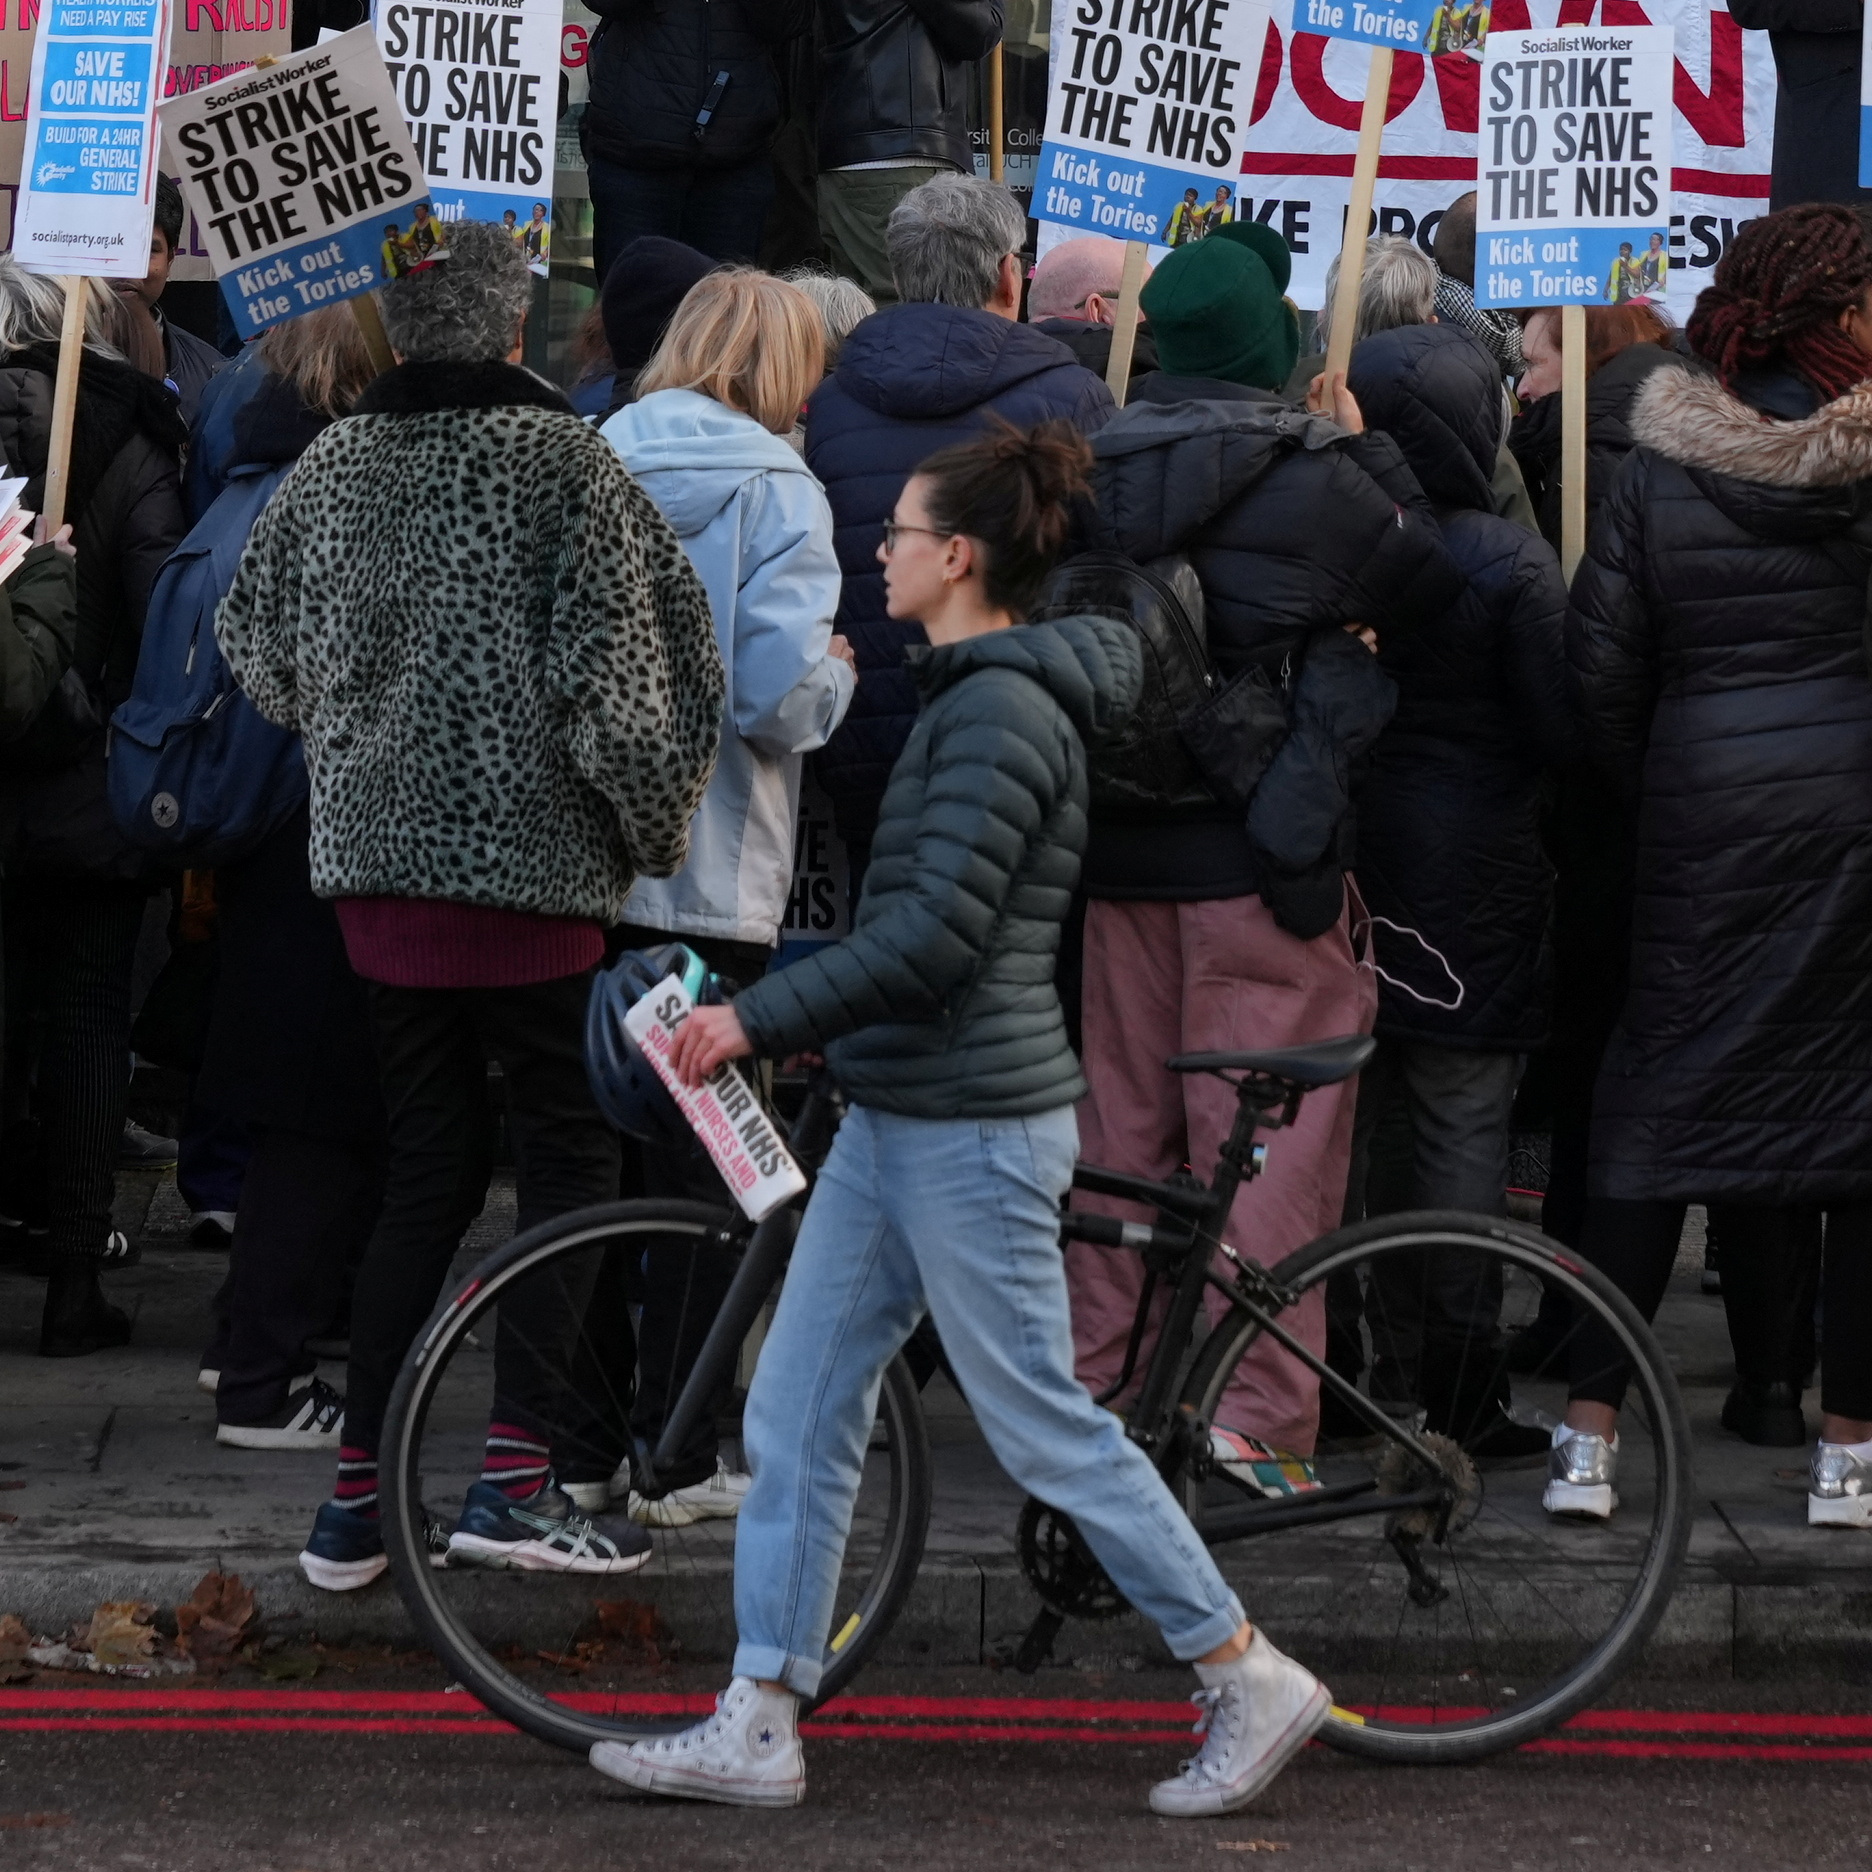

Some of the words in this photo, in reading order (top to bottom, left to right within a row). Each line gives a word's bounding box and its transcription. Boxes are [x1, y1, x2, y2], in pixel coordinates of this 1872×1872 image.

[385, 5, 523, 68] STRIKE
[1071, 27, 1122, 86] TO
[1135, 43, 1240, 112] SAVE
[178, 71, 350, 168] STRIKE
[445, 67, 540, 127] SAVE
[1489, 57, 1632, 112] STRIKE
[191, 158, 259, 215] TO
[271, 107, 391, 187] SAVE
[462, 127, 543, 186] NHS
[1060, 82, 1138, 148] THE
[1147, 103, 1235, 168] NHS
[1487, 114, 1537, 166] TO
[1552, 112, 1653, 163] SAVE
[208, 193, 306, 260] THE
[313, 152, 411, 225] NHS
[1486, 168, 1559, 220] THE
[1575, 166, 1658, 218] NHS
[695, 1091, 740, 1156] NURSES
[730, 1154, 757, 1189] AND
